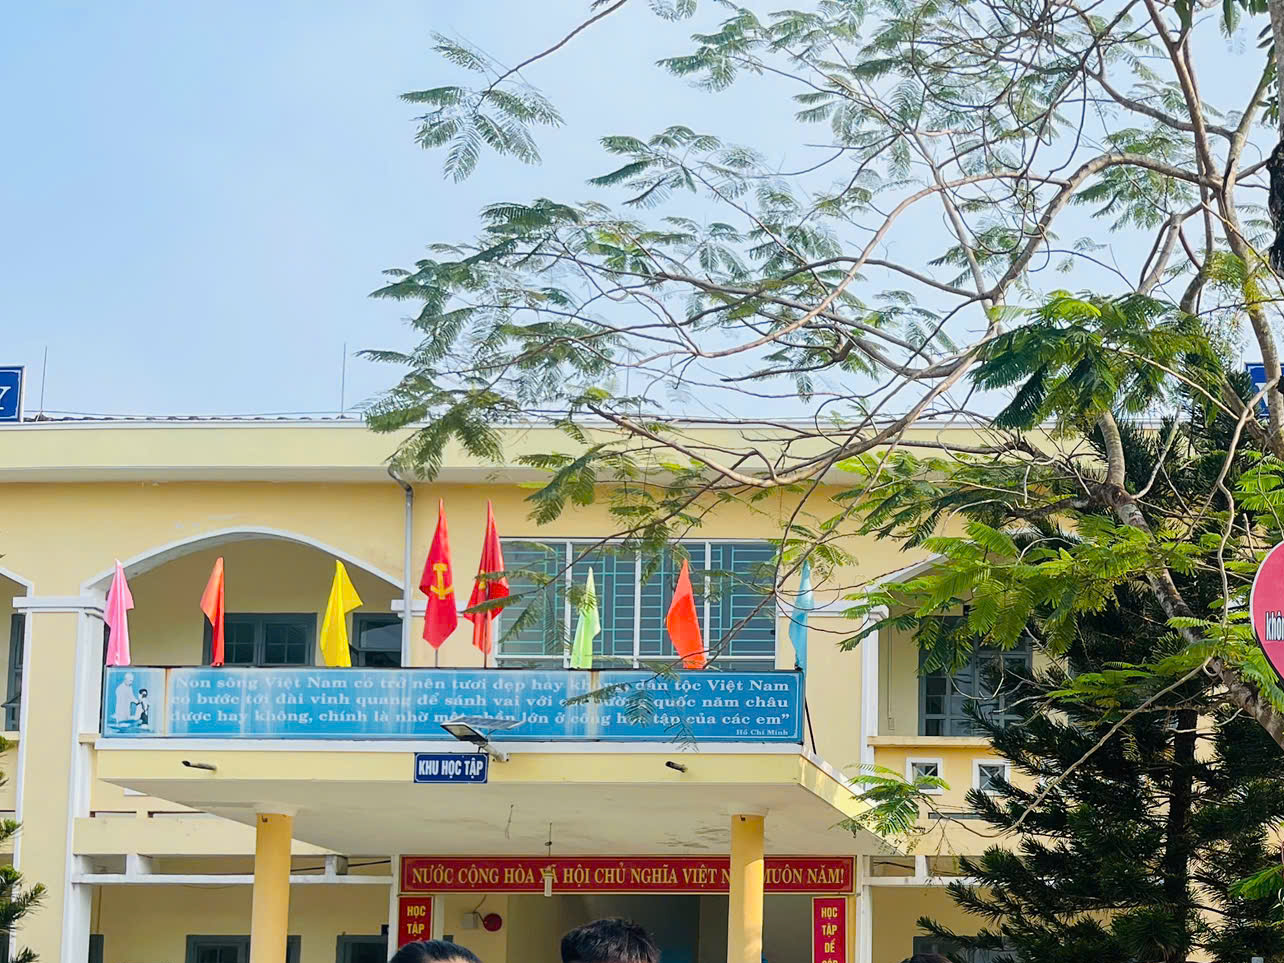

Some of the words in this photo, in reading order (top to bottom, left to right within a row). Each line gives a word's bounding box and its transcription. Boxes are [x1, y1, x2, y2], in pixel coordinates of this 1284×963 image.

[307, 677, 347, 689] Nam
[413, 678, 445, 689] nên
[707, 679, 743, 693] Việt
[749, 680, 789, 692] Nam
[311, 693, 351, 705] vinh
[493, 695, 520, 706] vai
[702, 695, 740, 707] năm
[745, 695, 788, 707] châu
[686, 712, 716, 724] của
[722, 712, 751, 724] các
[418, 760, 440, 775] KHU
[441, 760, 462, 779] HỌC
[464, 757, 484, 779] TẬP
[412, 863, 454, 884] NƯỚC
[458, 864, 499, 887] CỘNG
[503, 864, 535, 884] HÒA
[563, 864, 591, 887] HỘI
[594, 862, 626, 884] CHỦ
[630, 864, 678, 884] NGHĨA
[682, 865, 718, 888] VIỆT
[807, 865, 844, 884] NĂM!
[407, 905, 426, 919] HỌC
[821, 907, 838, 920] HỌC
[407, 921, 425, 937] TẬP
[821, 922, 838, 938] TẬP
